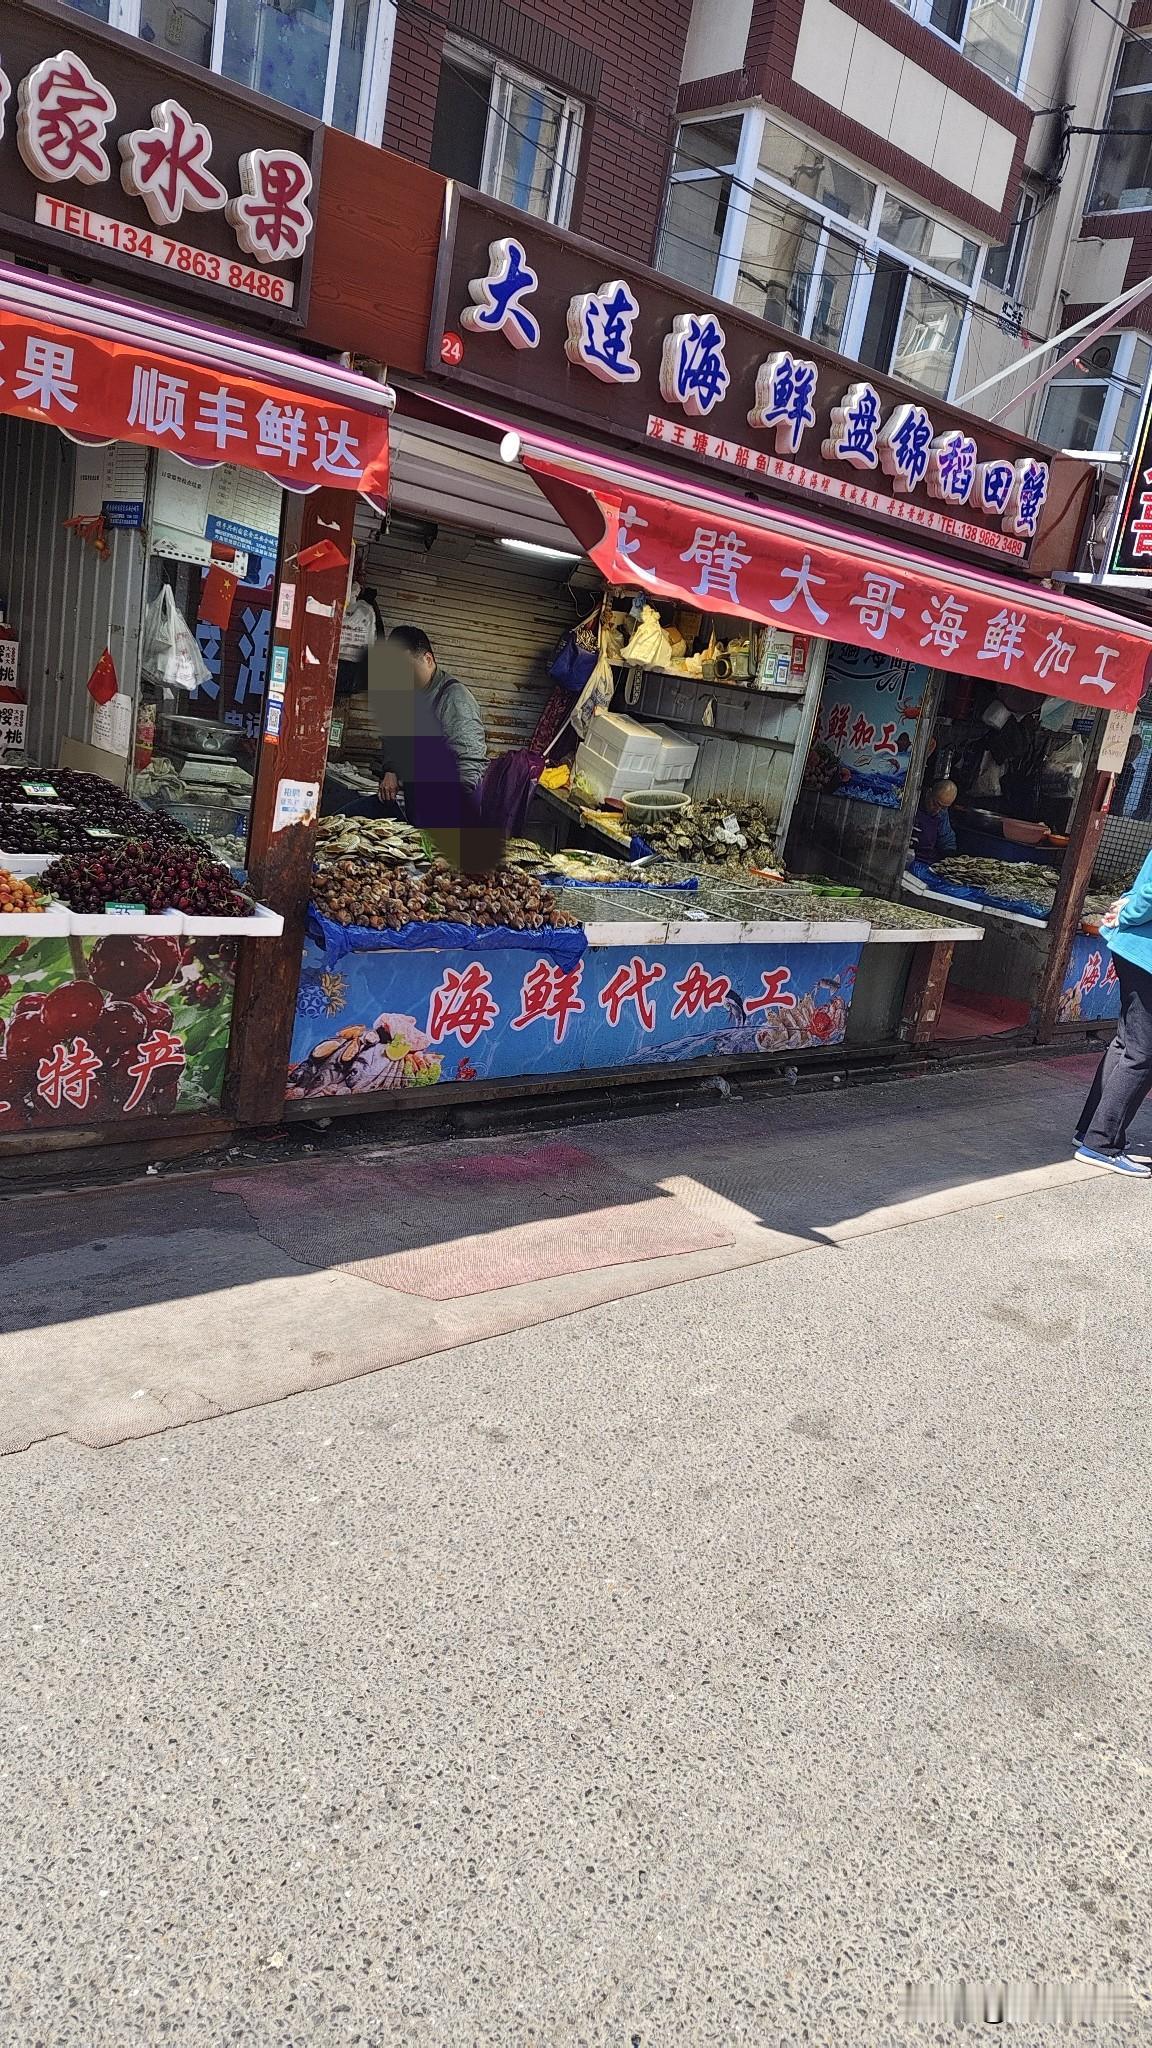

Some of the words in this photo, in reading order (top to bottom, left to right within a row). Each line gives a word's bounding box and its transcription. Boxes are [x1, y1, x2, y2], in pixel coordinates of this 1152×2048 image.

[0, 58, 308, 254] 家水果
[46, 197, 154, 259] TEL:134
[163, 241, 221, 281] 7863
[228, 264, 285, 304] 8486
[441, 337, 461, 360] 24
[476, 242, 1048, 533] 大连海鲜盘锦稻田蟹
[0, 335, 78, 413] 果
[126, 363, 364, 480] 顺丰鲜达
[648, 417, 769, 475] 龙王塘小船鱼
[940, 516, 977, 542] TEL:138
[979, 530, 1001, 549] 9862
[1002, 536, 1022, 556] 3489
[812, 704, 897, 756] 鲜加工
[429, 957, 799, 1043] 海鲜代加工
[0, 1031, 186, 1111] 特产
